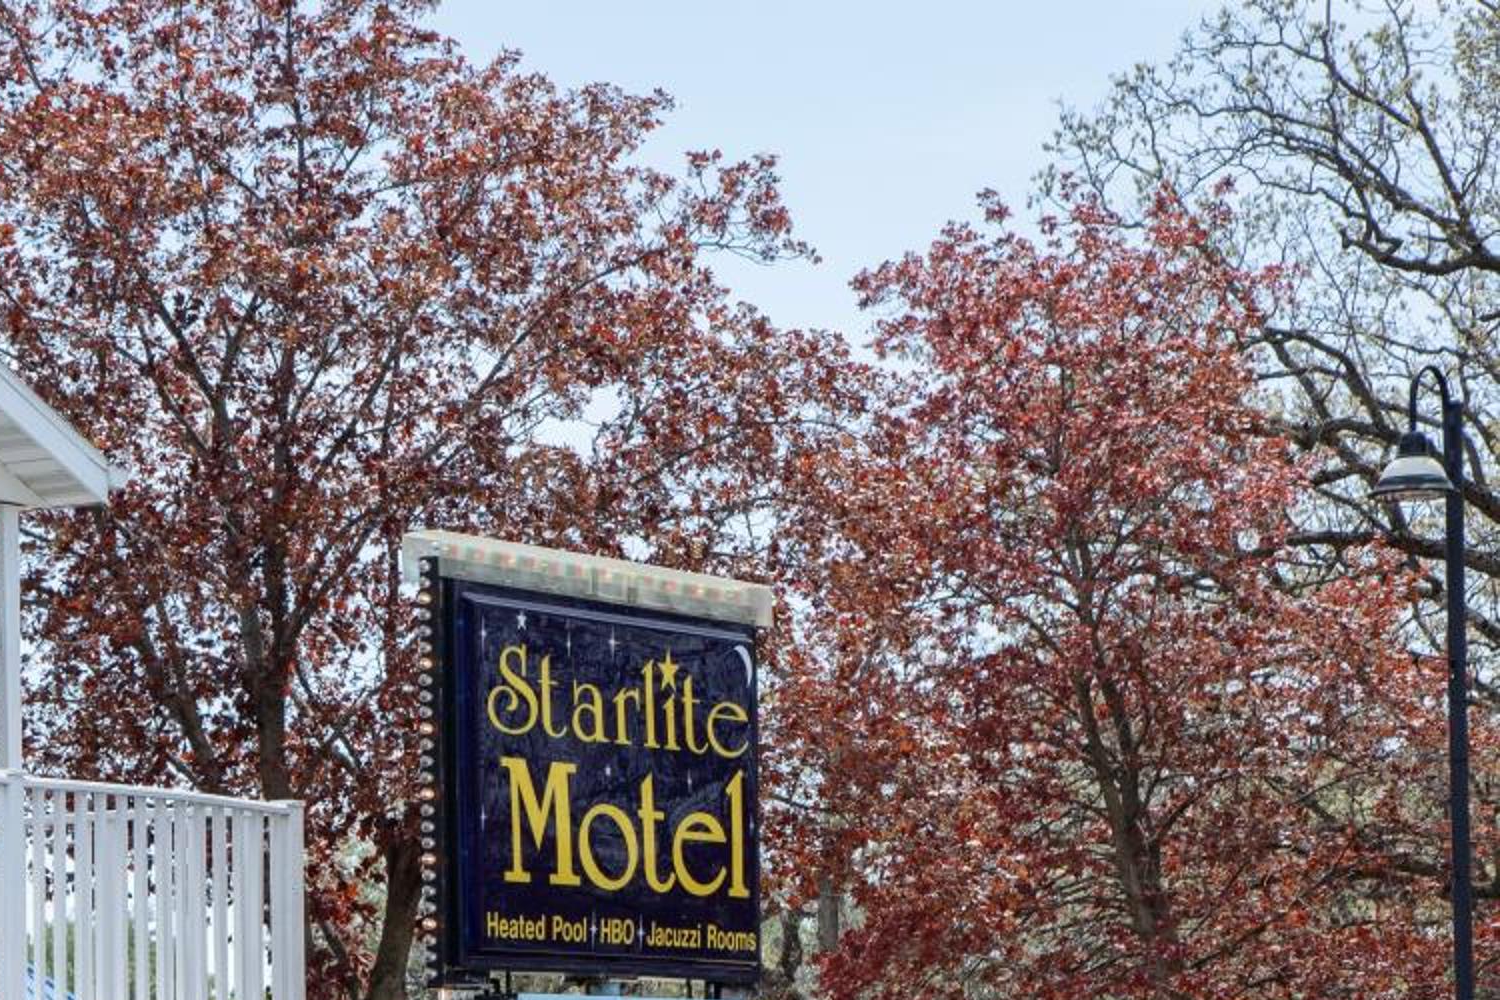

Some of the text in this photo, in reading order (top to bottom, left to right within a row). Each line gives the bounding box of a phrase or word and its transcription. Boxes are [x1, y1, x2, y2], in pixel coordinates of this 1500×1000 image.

[487, 643, 750, 760] Starlite
[500, 756, 751, 899] Motel
[487, 911, 757, 952] Heated Pool HBO Jacuzzi Rooms
